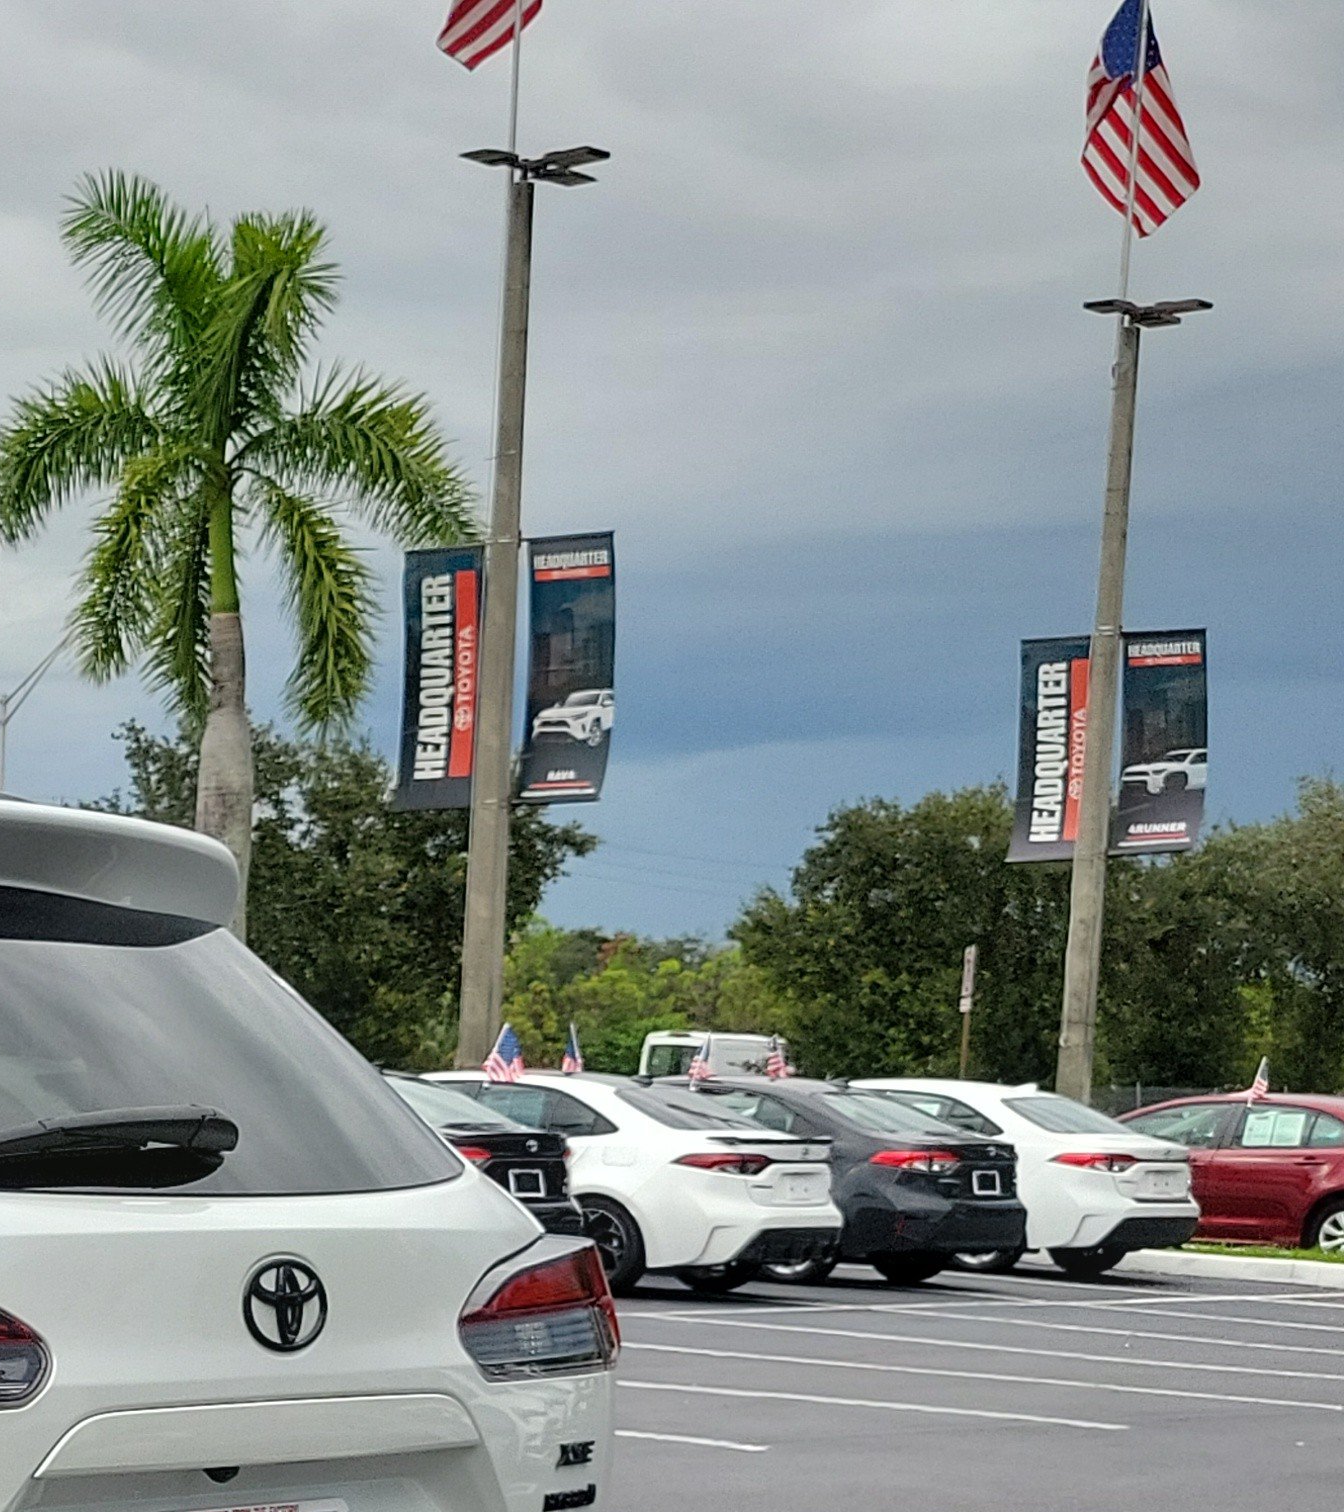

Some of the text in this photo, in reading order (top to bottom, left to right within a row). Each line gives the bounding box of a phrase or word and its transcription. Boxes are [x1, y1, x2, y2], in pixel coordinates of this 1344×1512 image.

[413, 573, 454, 781] HEADQUARTER
[456, 624, 475, 704] TOYOTA
[1029, 661, 1068, 842] HEADQUARTER
